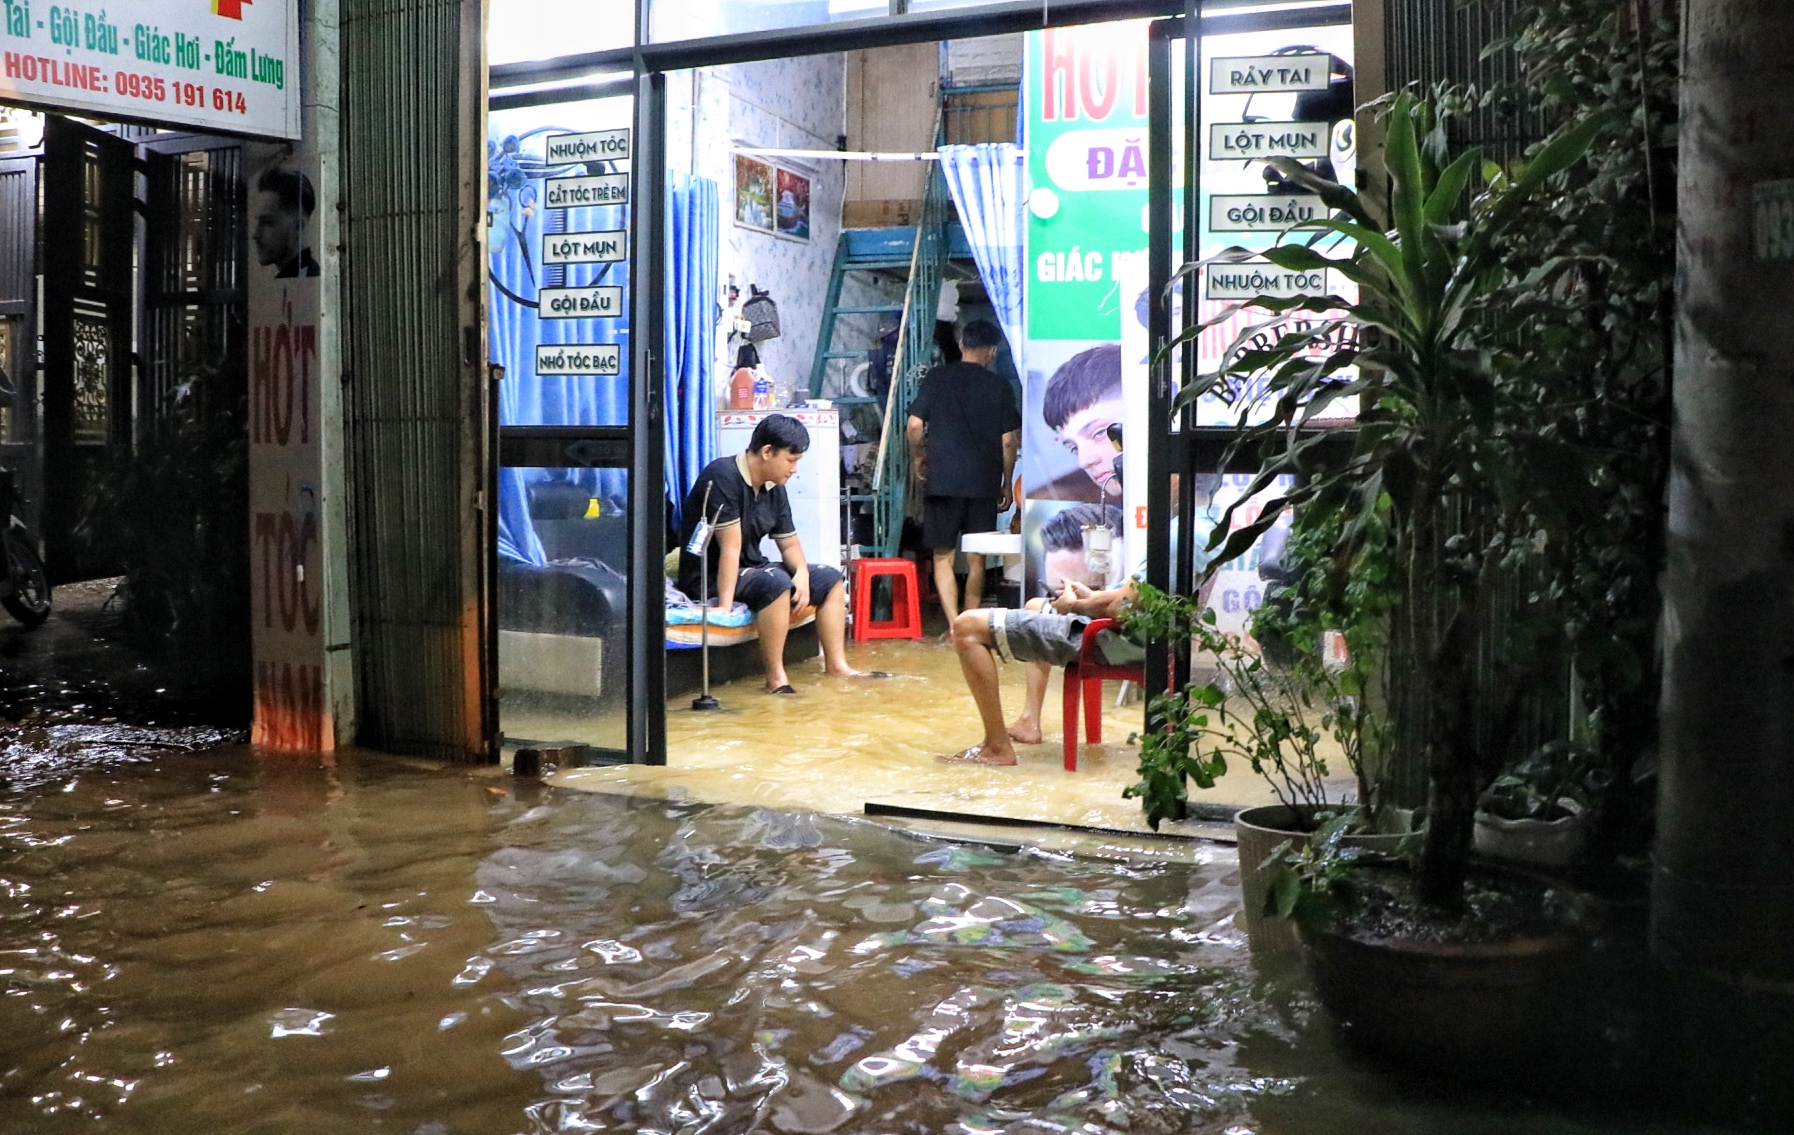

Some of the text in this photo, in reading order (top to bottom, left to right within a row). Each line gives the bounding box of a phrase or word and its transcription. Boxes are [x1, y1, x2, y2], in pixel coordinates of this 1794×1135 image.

[3, 0, 31, 38] Tai
[50, 5, 80, 55] Gội
[84, 9, 118, 55] Đầu
[134, 23, 170, 65] Giác
[175, 31, 200, 70] Hơi
[214, 37, 248, 79] Đấm
[251, 47, 284, 90] Lưng
[5, 51, 246, 114] HOTLINE: 0935 191 614
[1276, 67, 1311, 85] TAI
[549, 135, 627, 159] NHUỘM TÓC
[1223, 130, 1318, 154] LỘT MỤN
[1086, 138, 1147, 186] ĐẶ
[611, 185, 626, 200] EM
[1227, 199, 1314, 227] GỘI ĐẦU
[552, 239, 617, 260] LỘT MỤN
[1037, 245, 1103, 282] GIÁC
[1212, 270, 1280, 294] NHUỘM
[551, 291, 611, 315] GỘI ĐẦU
[567, 352, 591, 369] TÓC
[593, 355, 617, 372] BẠC
